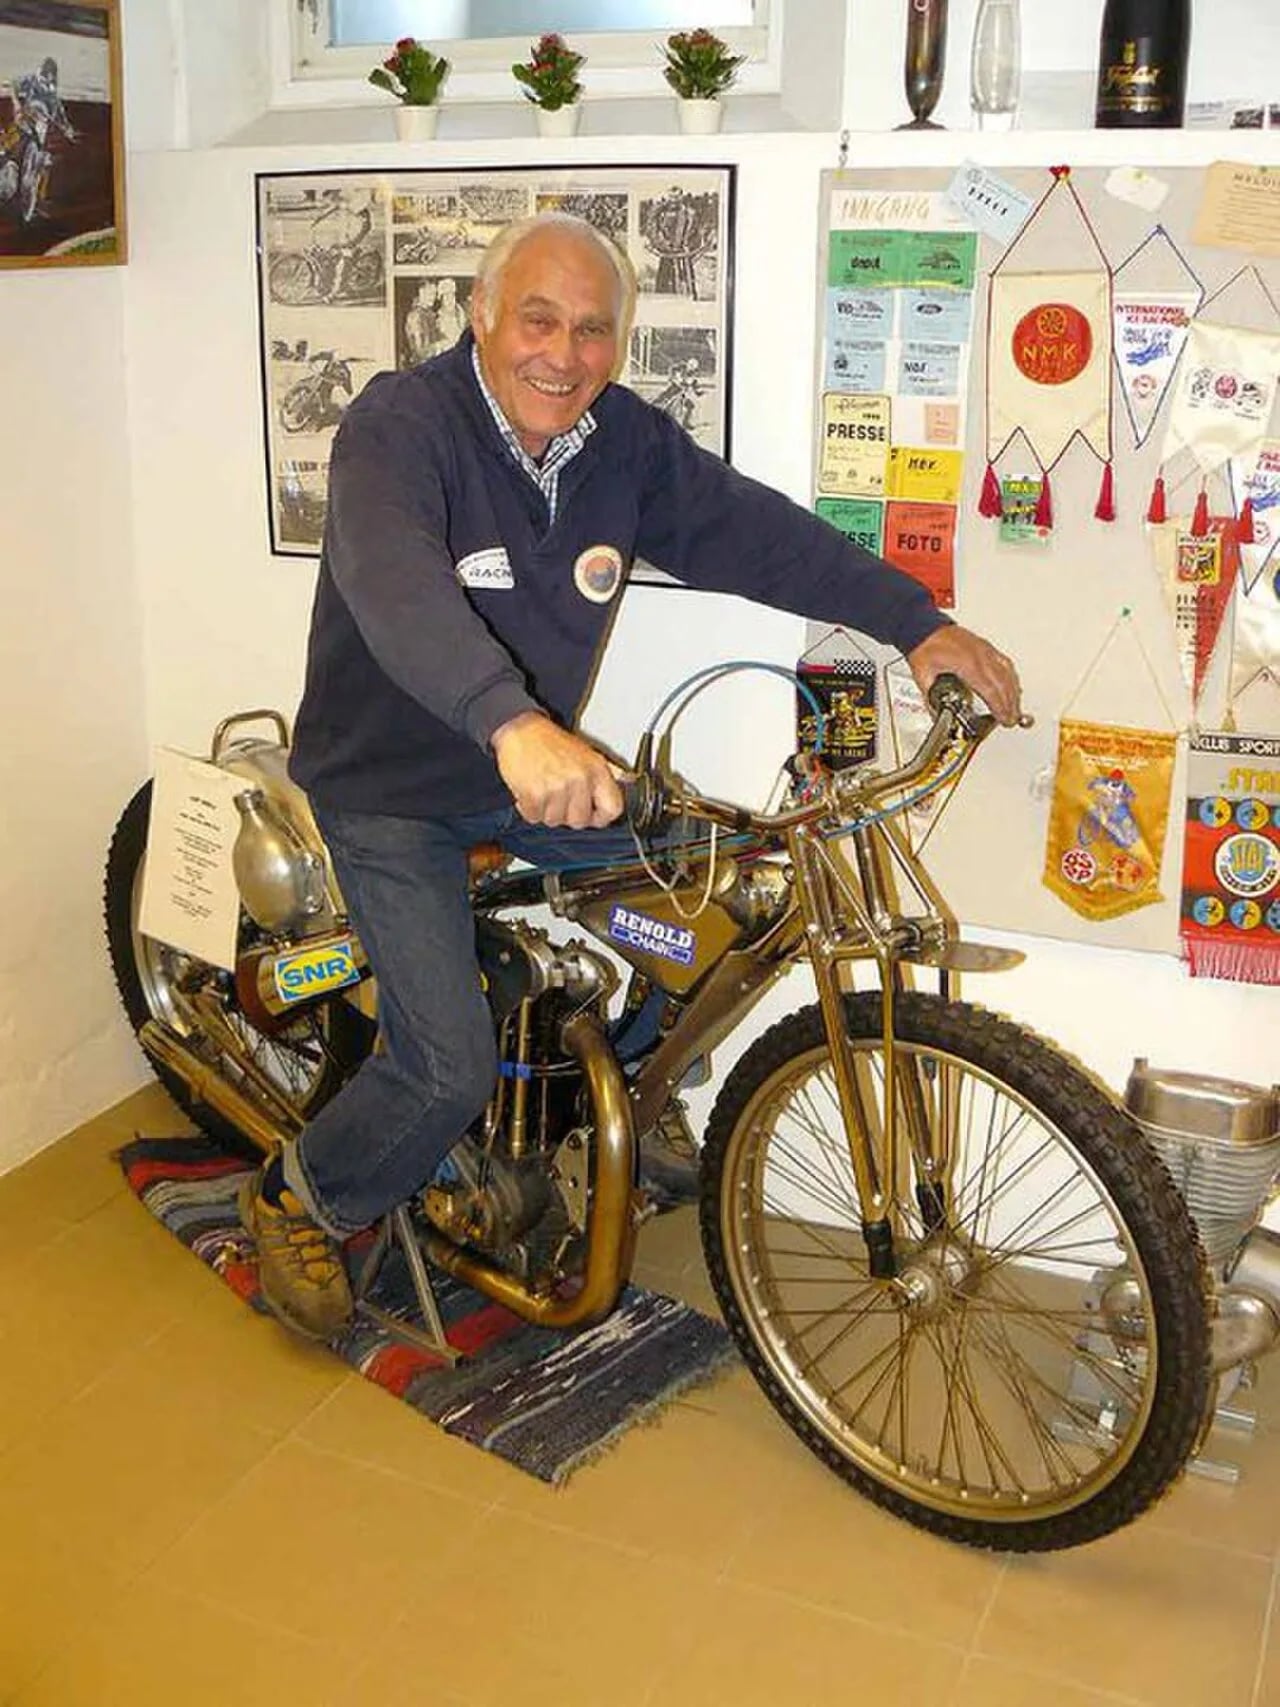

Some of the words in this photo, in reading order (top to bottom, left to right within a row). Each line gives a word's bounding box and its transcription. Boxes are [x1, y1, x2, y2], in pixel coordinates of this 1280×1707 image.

[1023, 343, 1077, 361] NMK
[827, 423, 886, 442] PRESSE
[897, 534, 942, 552] FOTO
[612, 907, 693, 949] RENOLD
[629, 932, 669, 956] CHAIN
[283, 957, 346, 987] SNR
